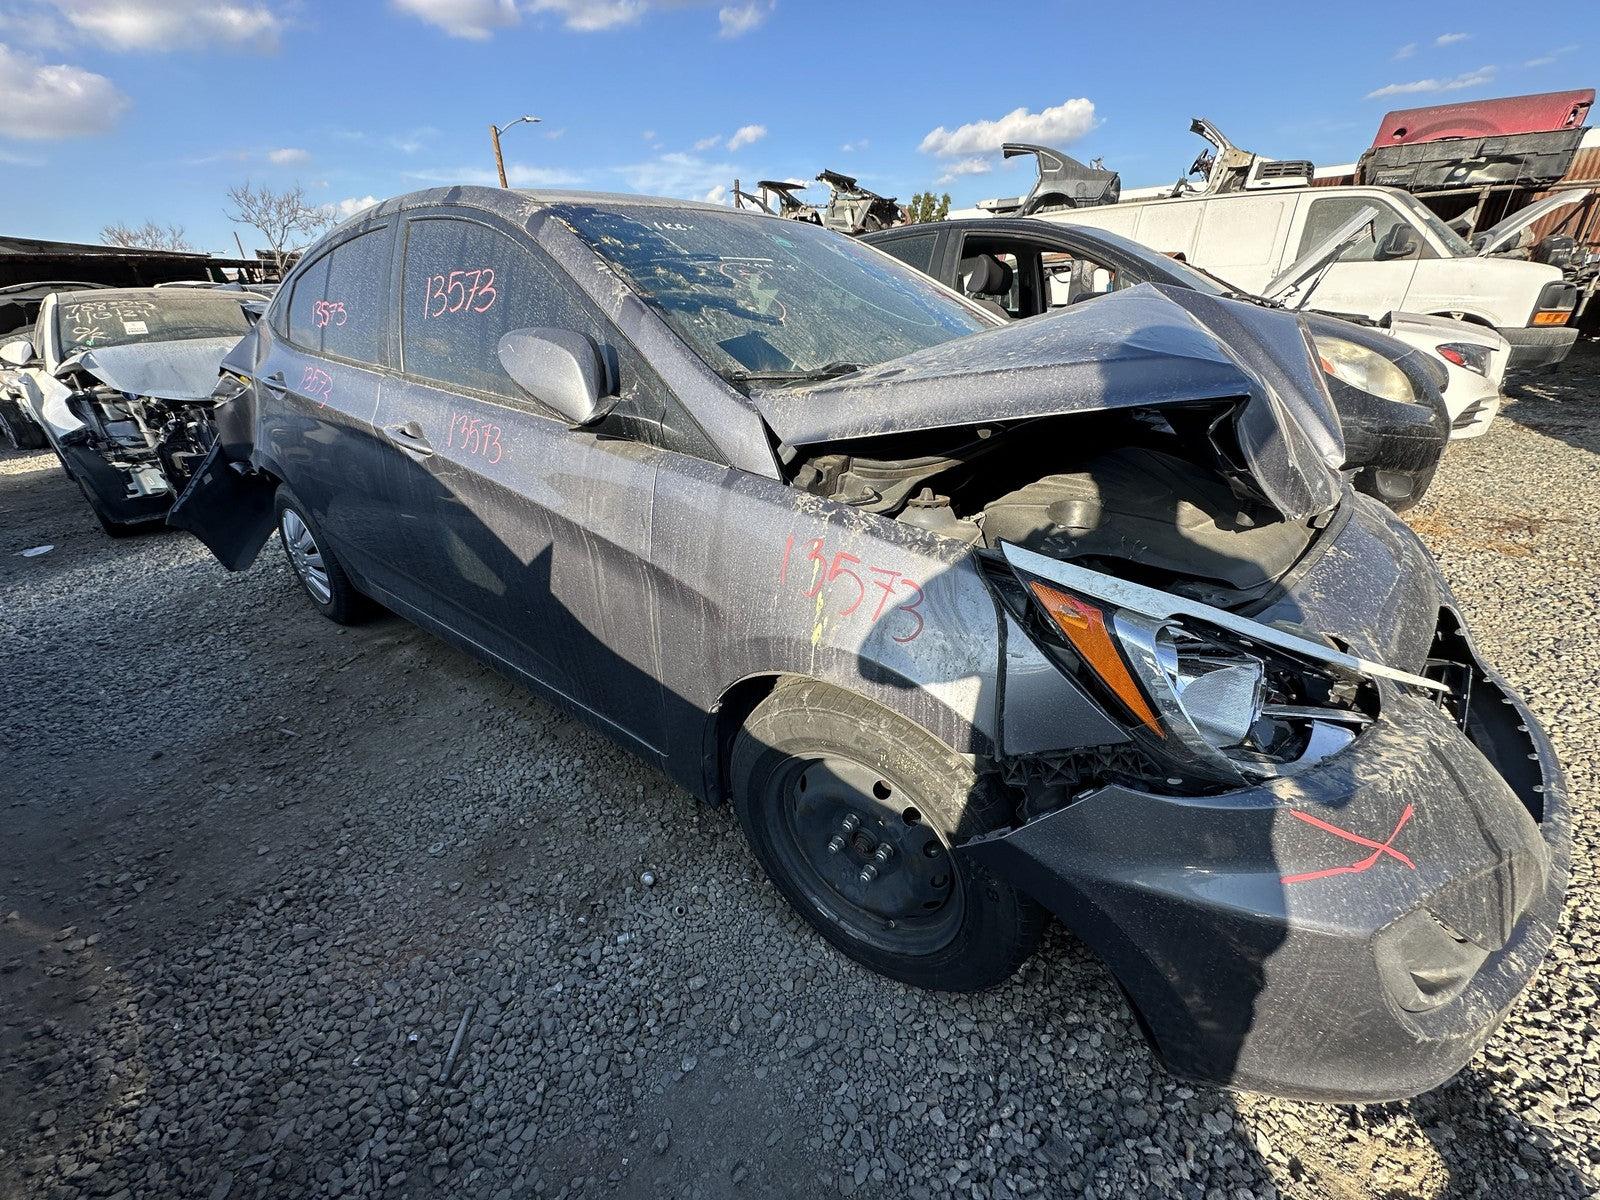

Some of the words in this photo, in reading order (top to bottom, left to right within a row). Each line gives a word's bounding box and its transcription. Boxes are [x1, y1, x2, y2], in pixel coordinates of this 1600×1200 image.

[311, 300, 348, 328] 13573
[423, 268, 497, 320] 13573
[448, 412, 502, 465] 13573
[780, 534, 925, 644] 13573
